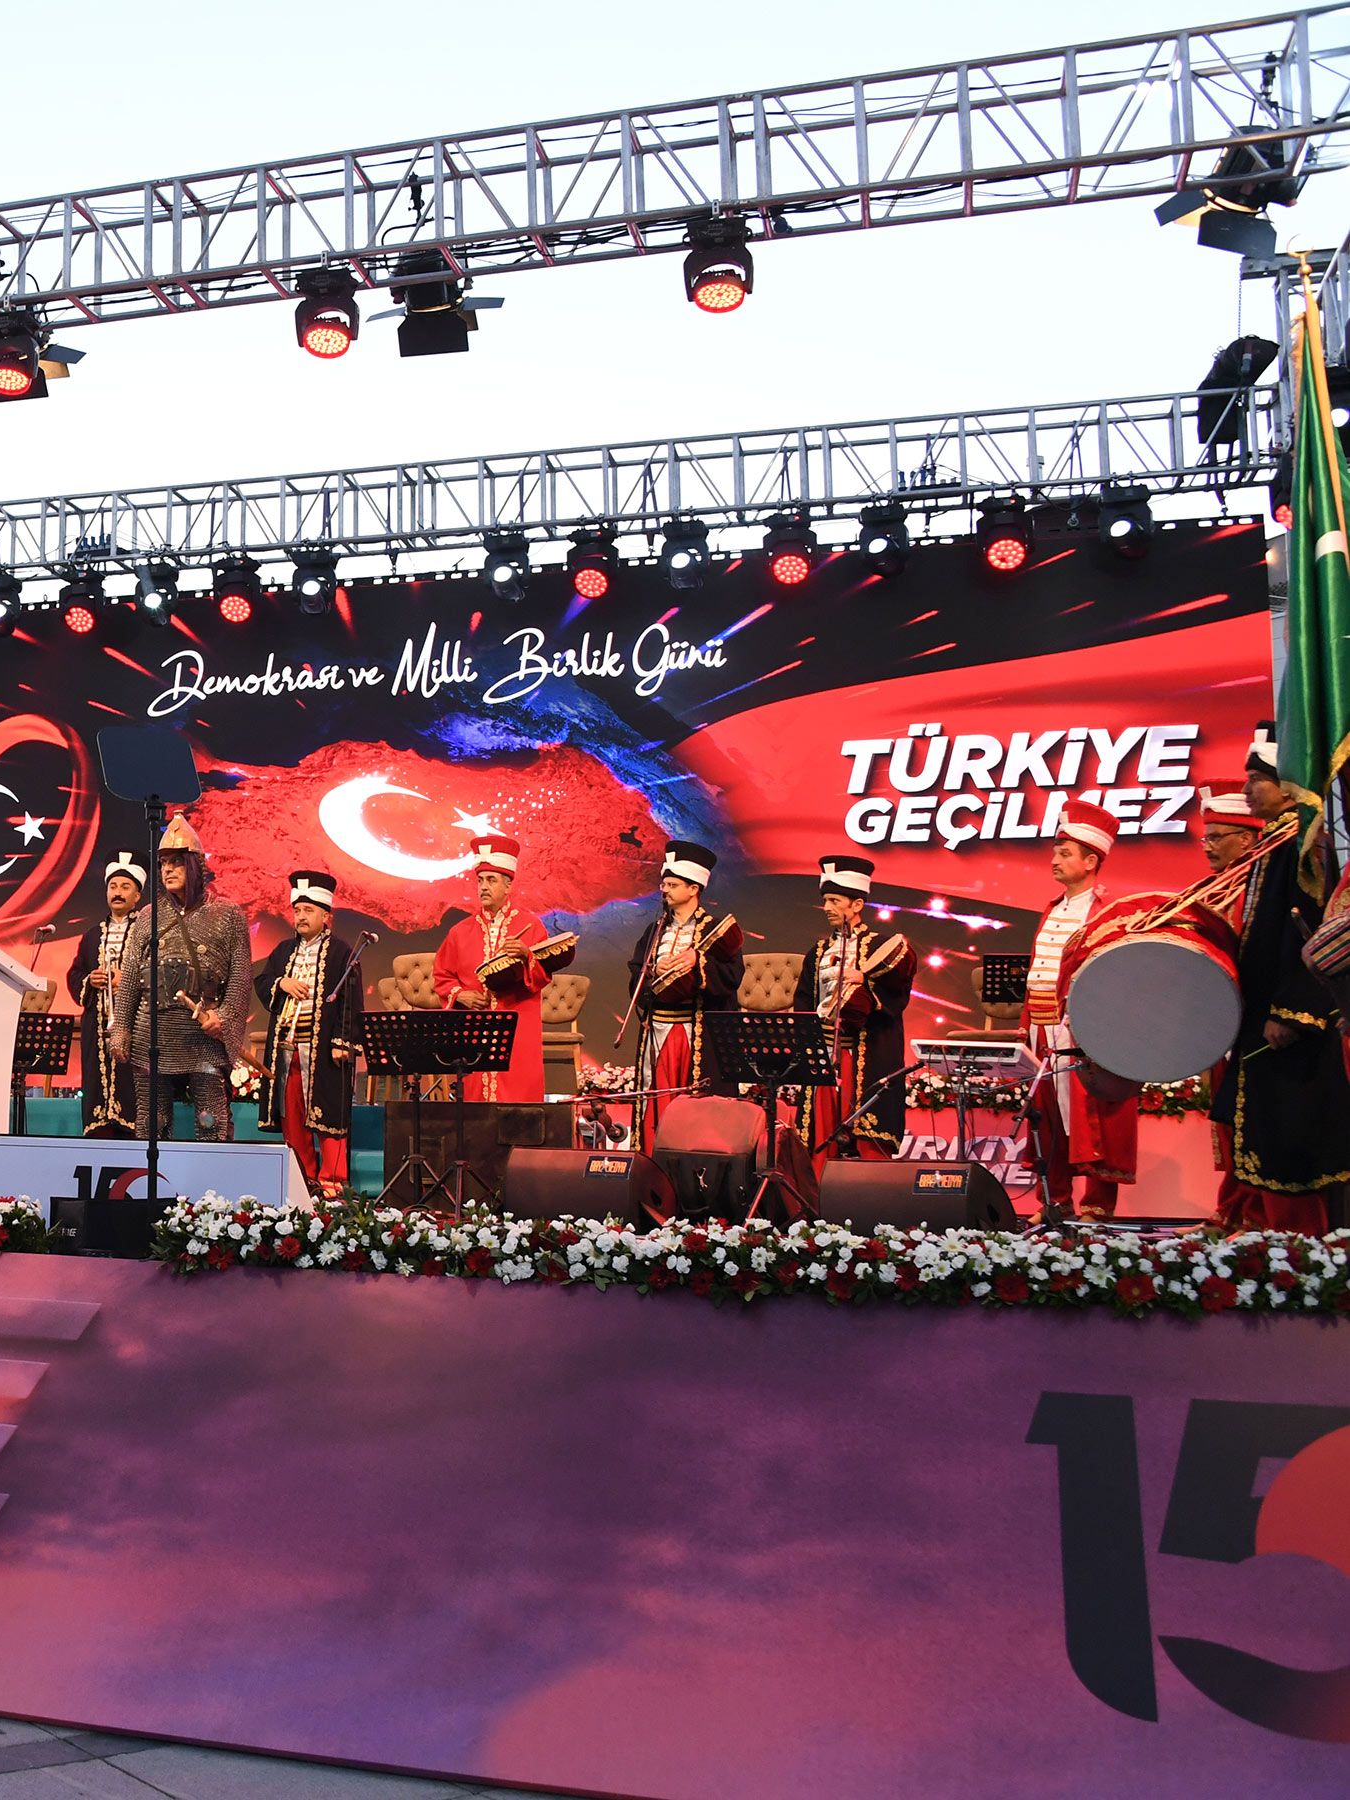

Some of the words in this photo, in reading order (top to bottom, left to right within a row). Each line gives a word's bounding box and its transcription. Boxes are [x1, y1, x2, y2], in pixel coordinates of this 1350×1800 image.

[147, 649, 344, 717] Demokrasi
[349, 665, 385, 688] ve
[391, 621, 479, 698] Milli
[483, 626, 626, 704] Birlik
[632, 622, 728, 697] Günü
